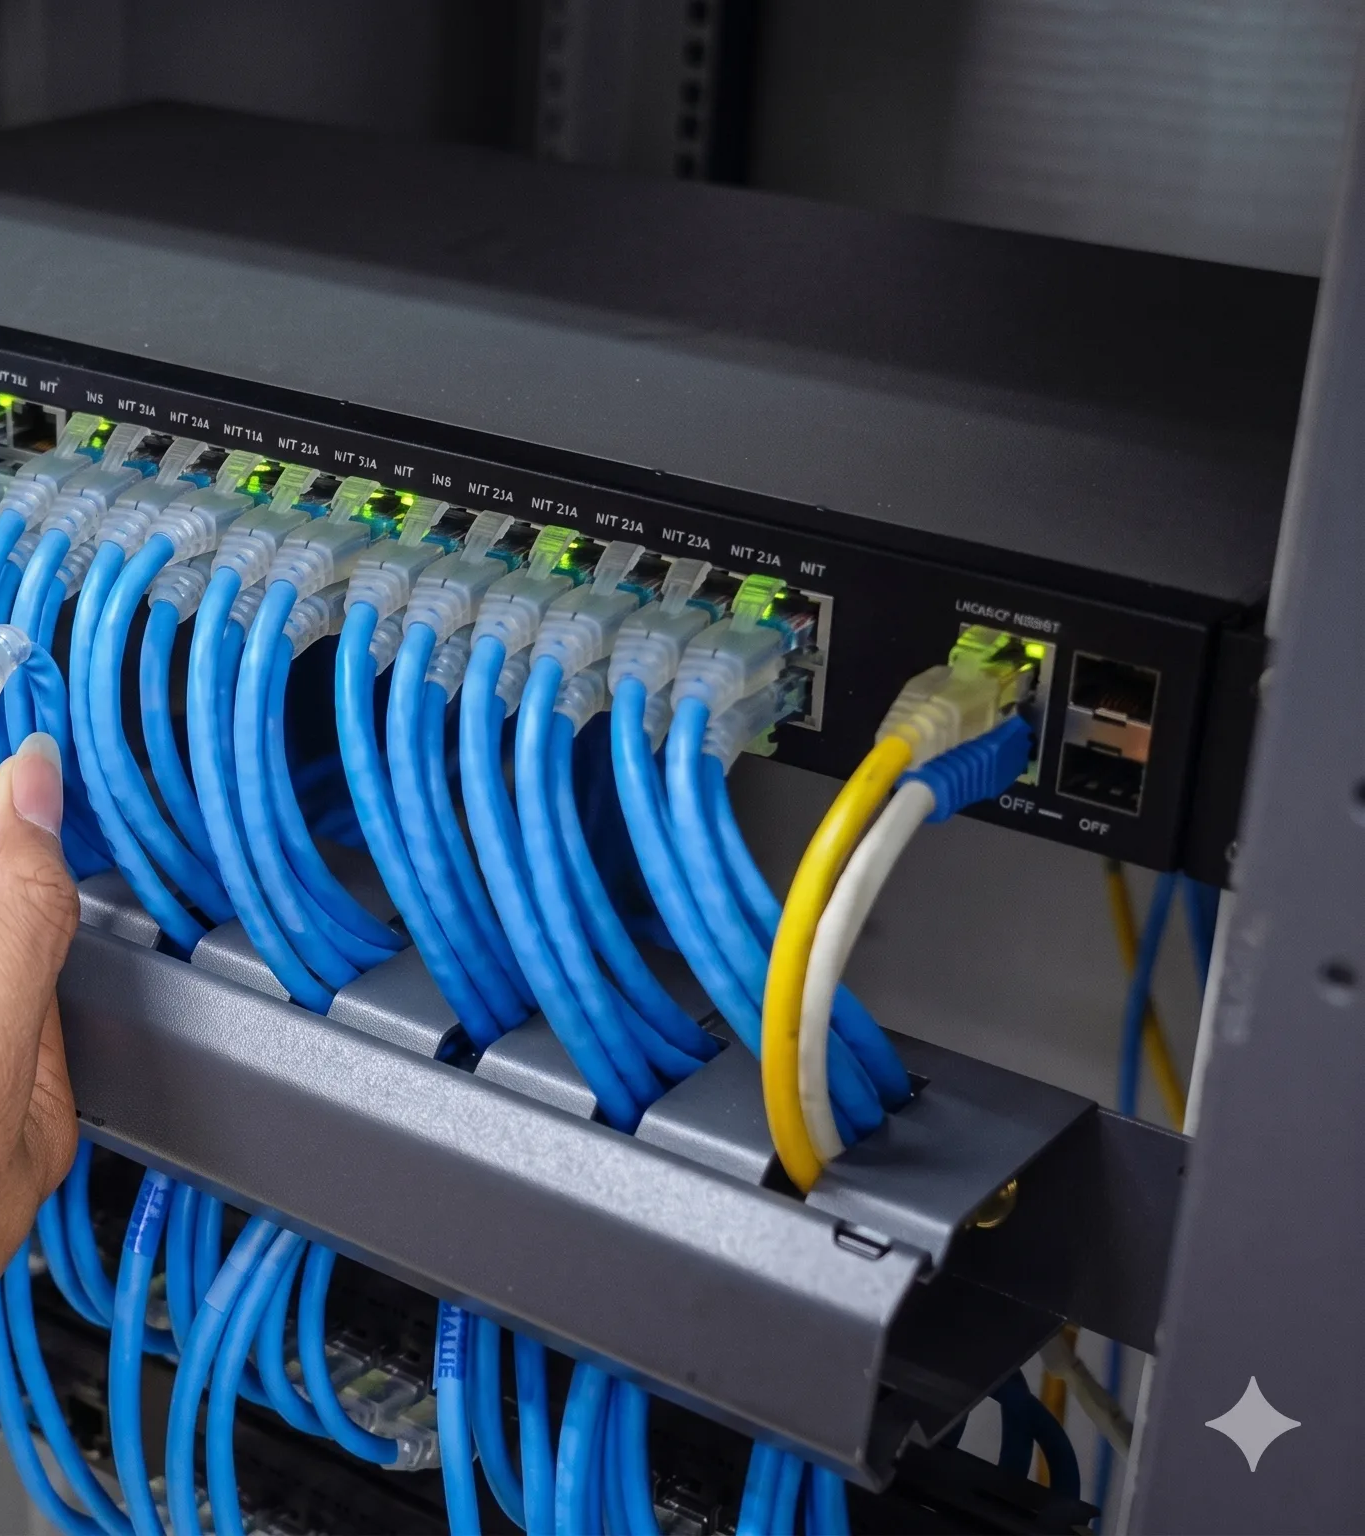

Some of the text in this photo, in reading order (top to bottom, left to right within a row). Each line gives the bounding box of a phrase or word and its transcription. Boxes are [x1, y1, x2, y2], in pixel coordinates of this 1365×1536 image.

[118, 399, 136, 412] NIT
[223, 423, 243, 437] NIT
[278, 437, 297, 450] NIT
[335, 450, 355, 464] NIT
[394, 464, 414, 478] NIT
[468, 482, 490, 496] NIT
[531, 497, 554, 512] NIT
[596, 512, 618, 527] NIT
[662, 528, 685, 543] NIT
[730, 545, 755, 560] NIT
[800, 561, 826, 577] NIT
[999, 794, 1035, 814] OFF
[1079, 818, 1110, 835] OFF
